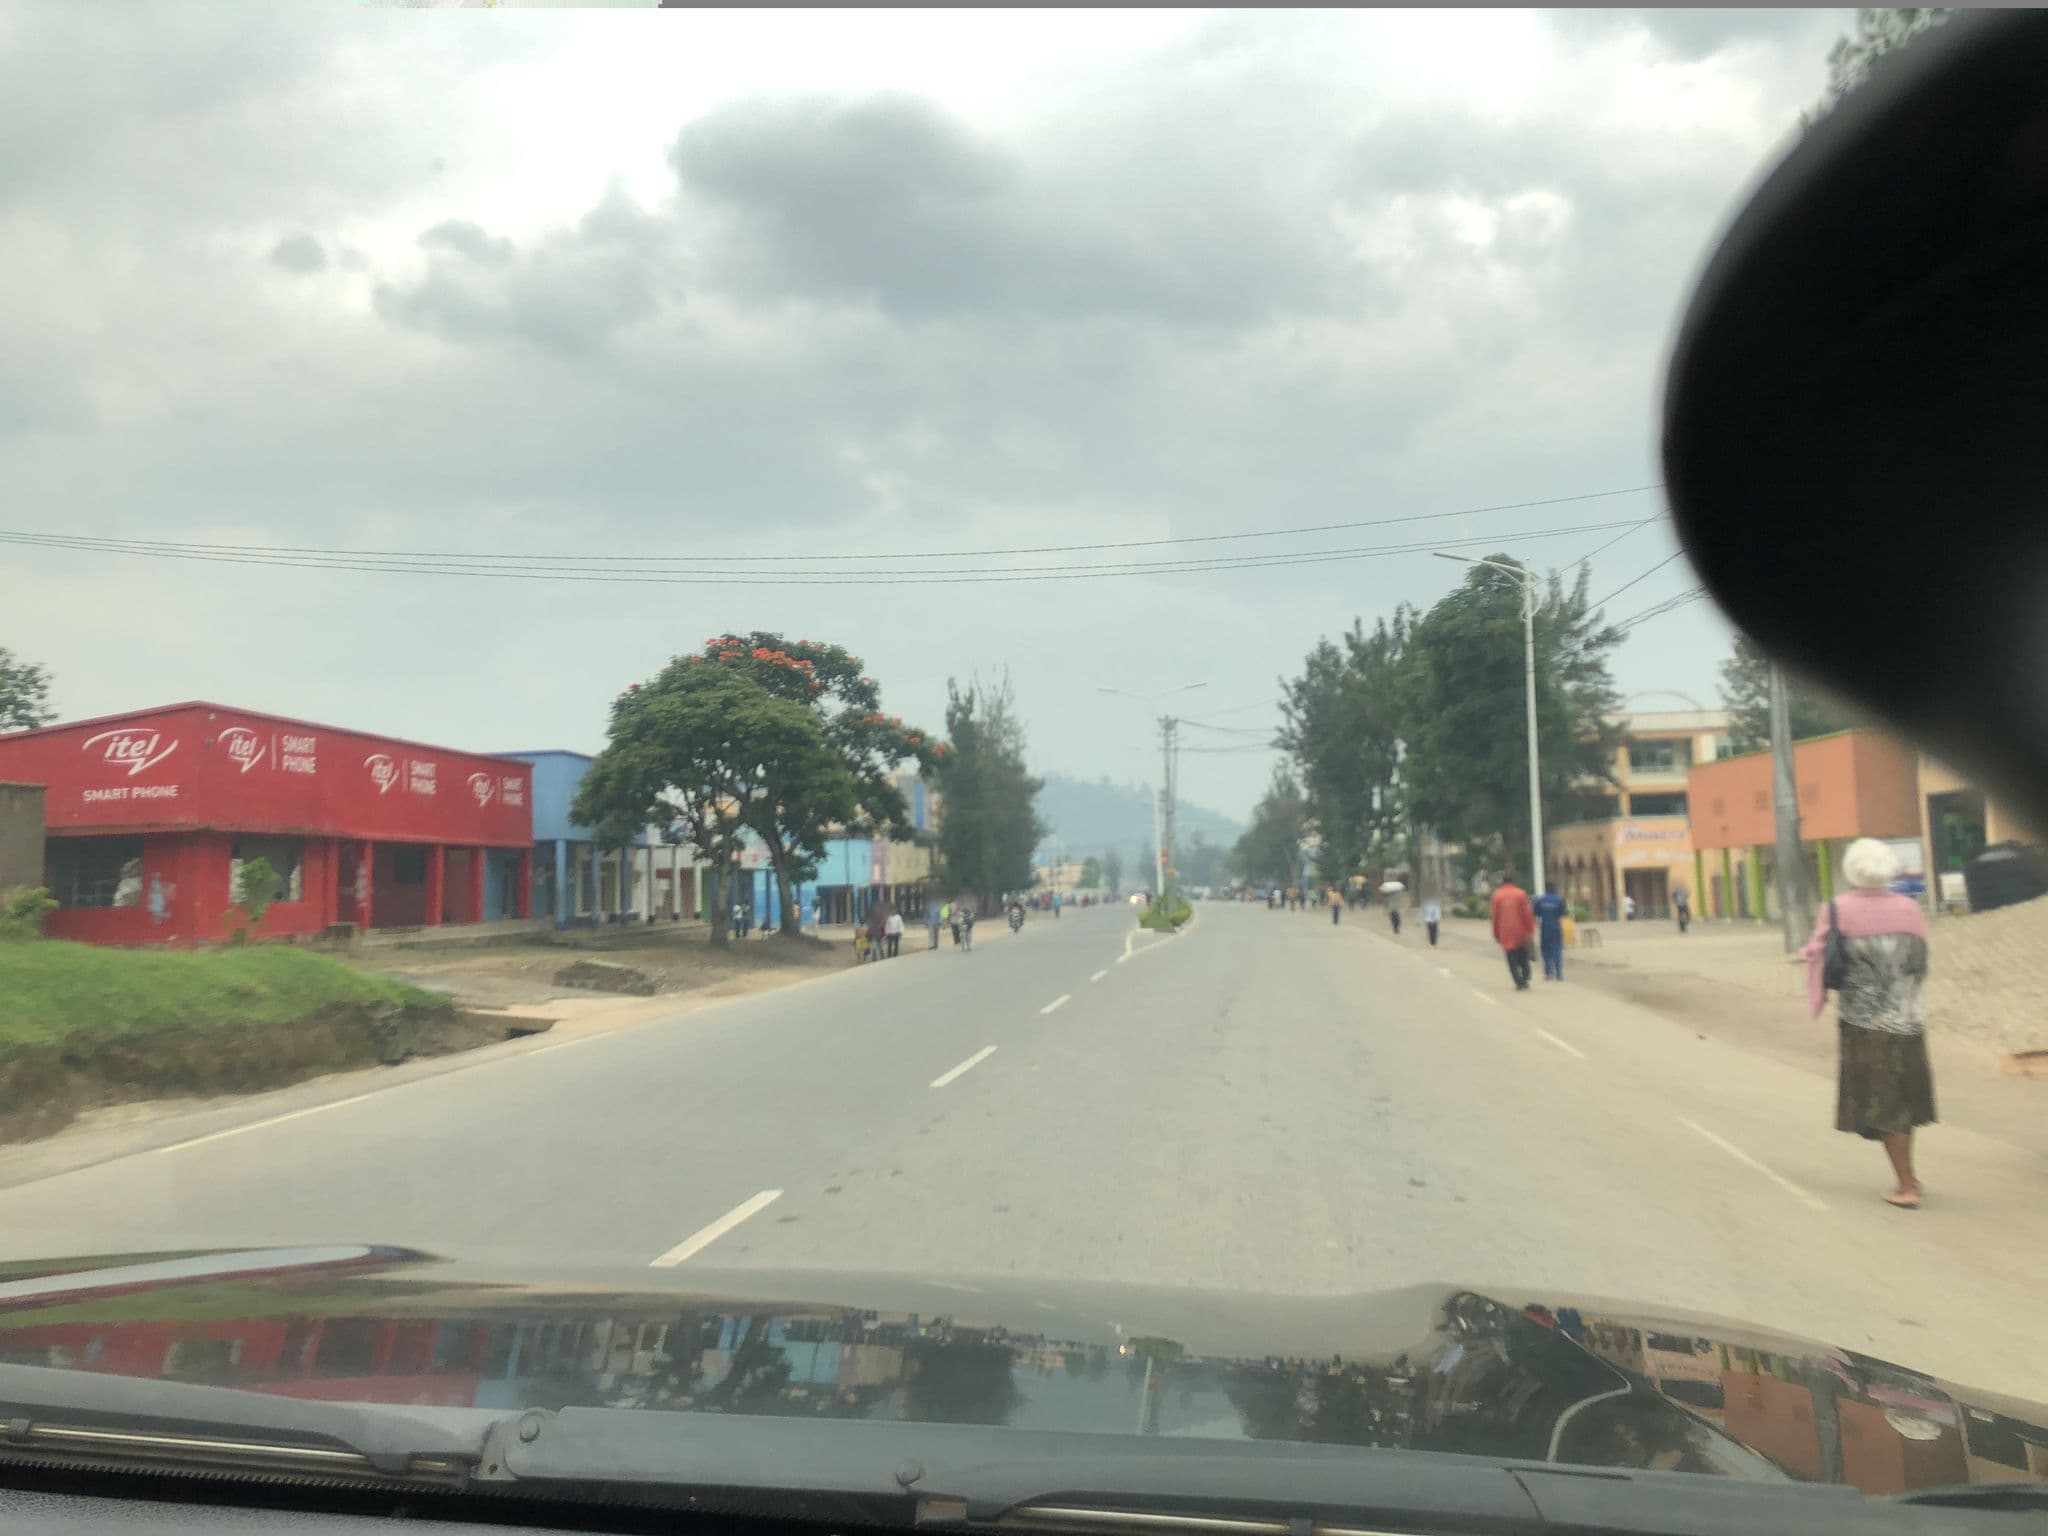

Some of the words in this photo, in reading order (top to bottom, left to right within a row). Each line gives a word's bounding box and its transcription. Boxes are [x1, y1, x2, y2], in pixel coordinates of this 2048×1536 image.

[104, 733, 160, 758] itel
[282, 735, 316, 754] SMART
[282, 754, 317, 774] PHONE
[83, 788, 130, 802] SMART
[132, 785, 178, 799] PHONE
